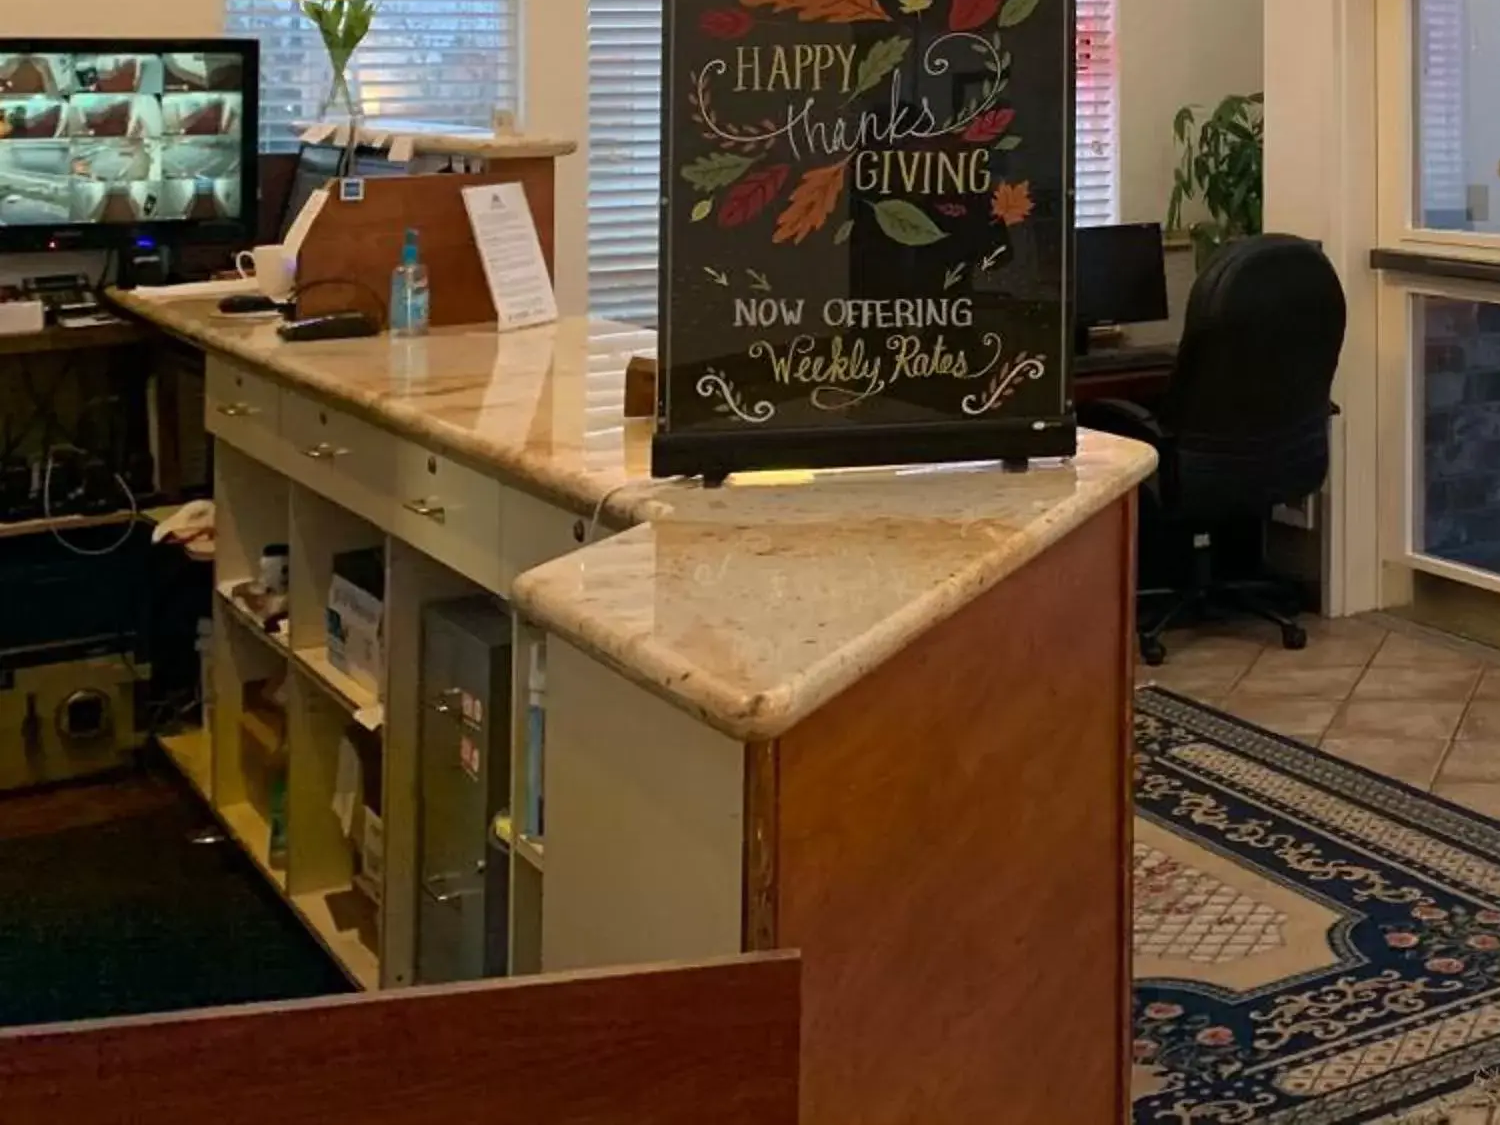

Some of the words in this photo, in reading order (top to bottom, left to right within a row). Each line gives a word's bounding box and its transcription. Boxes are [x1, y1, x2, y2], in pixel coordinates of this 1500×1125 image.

[733, 44, 856, 93] HAPPY
[855, 148, 992, 195] GIVING
[734, 298, 804, 326] NOW
[823, 298, 973, 327] OFFERING
[749, 334, 885, 410] Weekly
[886, 334, 1001, 383] Rates
